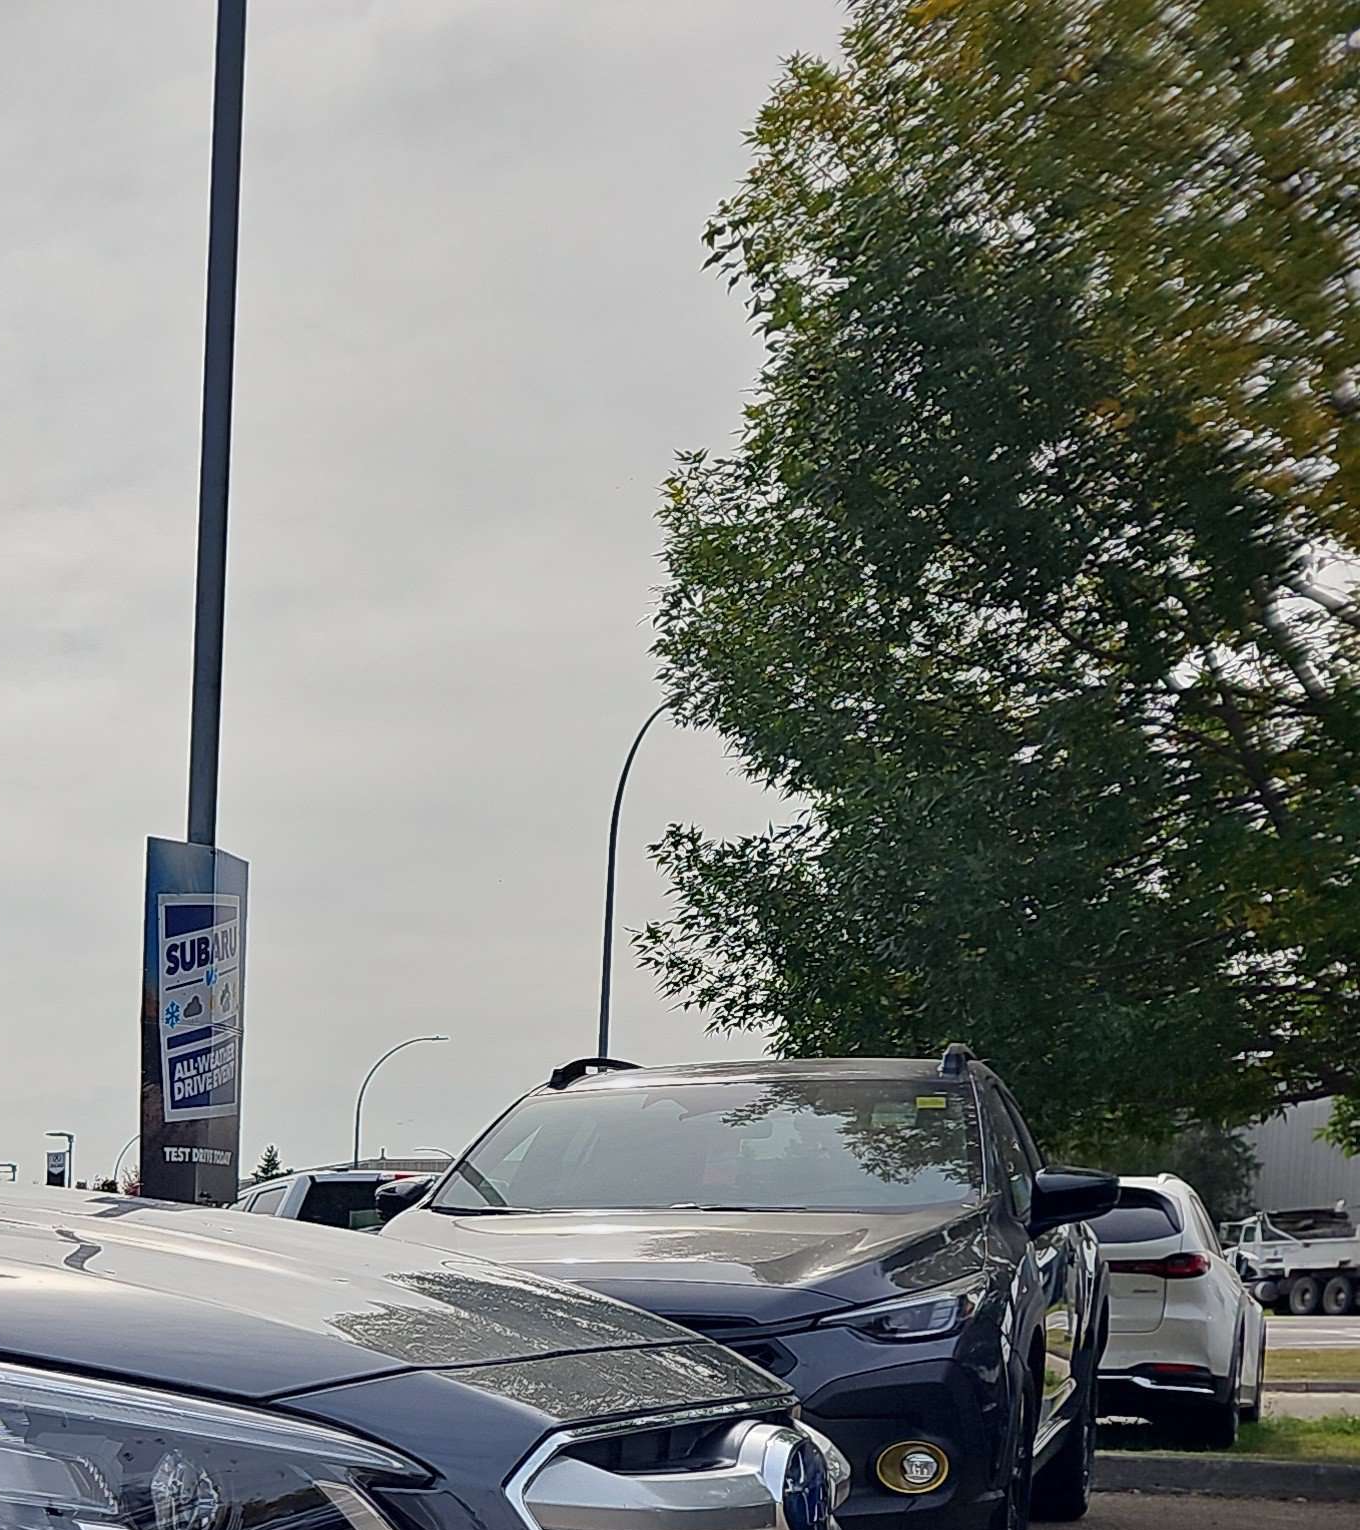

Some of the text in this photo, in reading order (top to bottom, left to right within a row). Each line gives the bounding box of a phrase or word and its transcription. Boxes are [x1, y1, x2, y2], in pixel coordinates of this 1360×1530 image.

[165, 926, 238, 976] SUBARU
[173, 1073, 213, 1102] DRIVE
[163, 1146, 191, 1162] TEST
